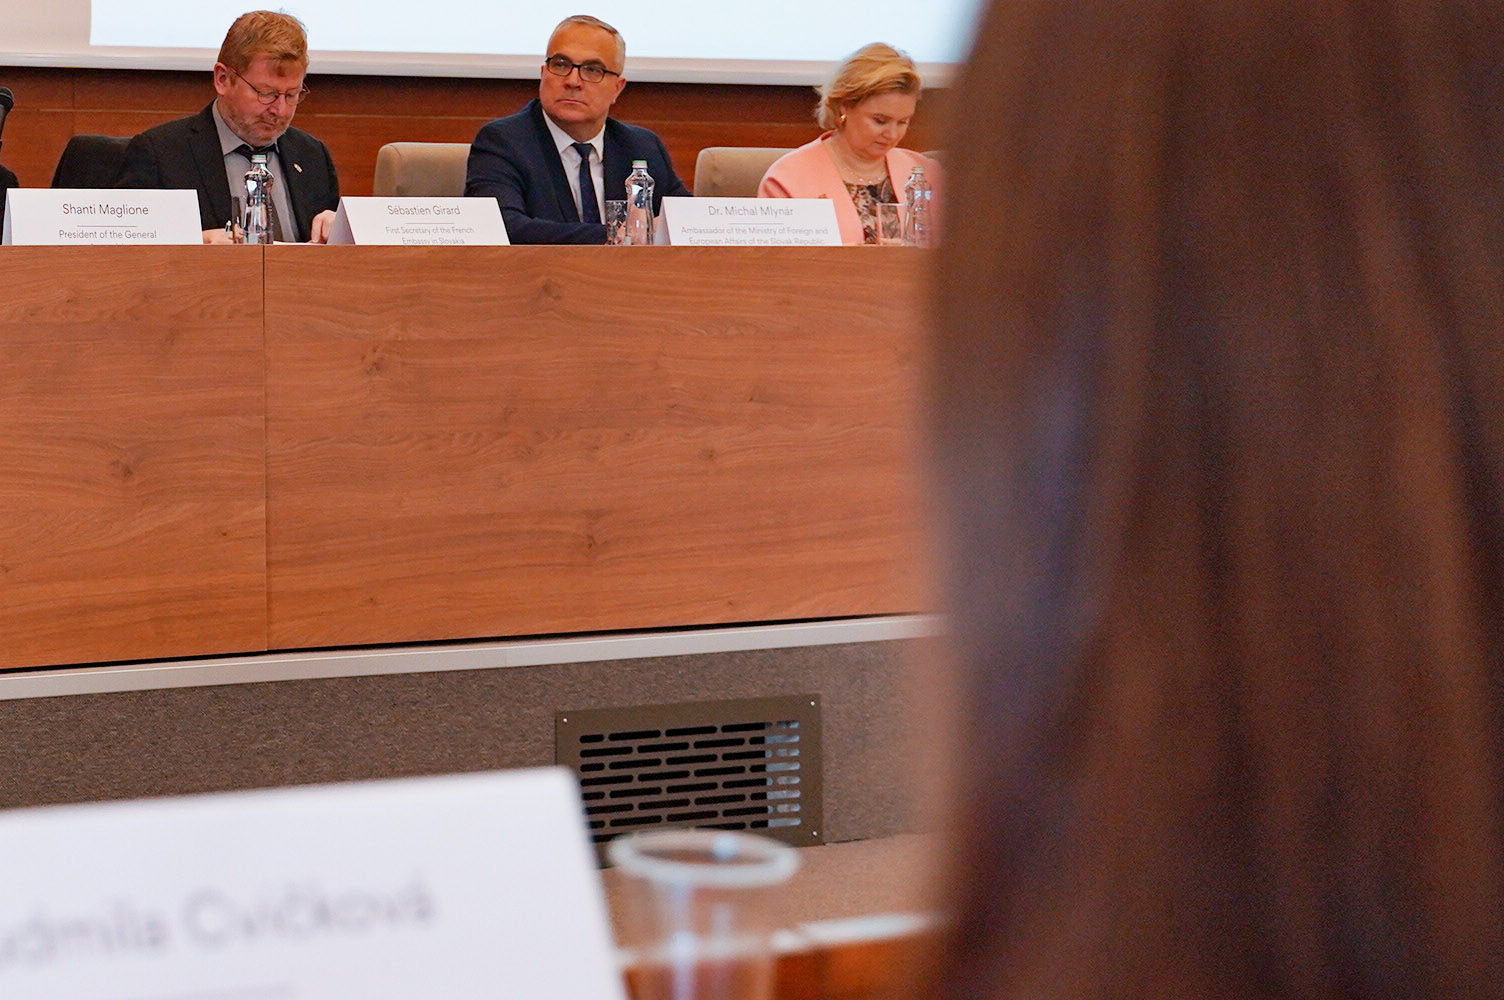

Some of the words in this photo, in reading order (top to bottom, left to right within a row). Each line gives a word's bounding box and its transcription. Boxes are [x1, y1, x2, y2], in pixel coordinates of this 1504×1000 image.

[62, 203, 96, 215] Shanti
[99, 204, 149, 218] Maglione
[387, 204, 431, 216] Sébastien
[433, 205, 461, 216] Girard
[708, 206, 723, 216] Dr.
[725, 206, 757, 216] Michal
[760, 206, 794, 218] Mlynár
[59, 229, 98, 239] President
[100, 229, 109, 239] of
[109, 229, 123, 239] the
[124, 229, 157, 239] General
[385, 226, 400, 234] First
[401, 226, 431, 235] Secretary
[432, 226, 440, 234] of
[681, 227, 725, 235] Ambassador
[726, 227, 734, 235] of
[735, 227, 747, 235] the
[749, 227, 778, 236] Ministry
[787, 228, 813, 236] Foreign
[689, 237, 723, 246] European
[794, 238, 825, 246] Republic
